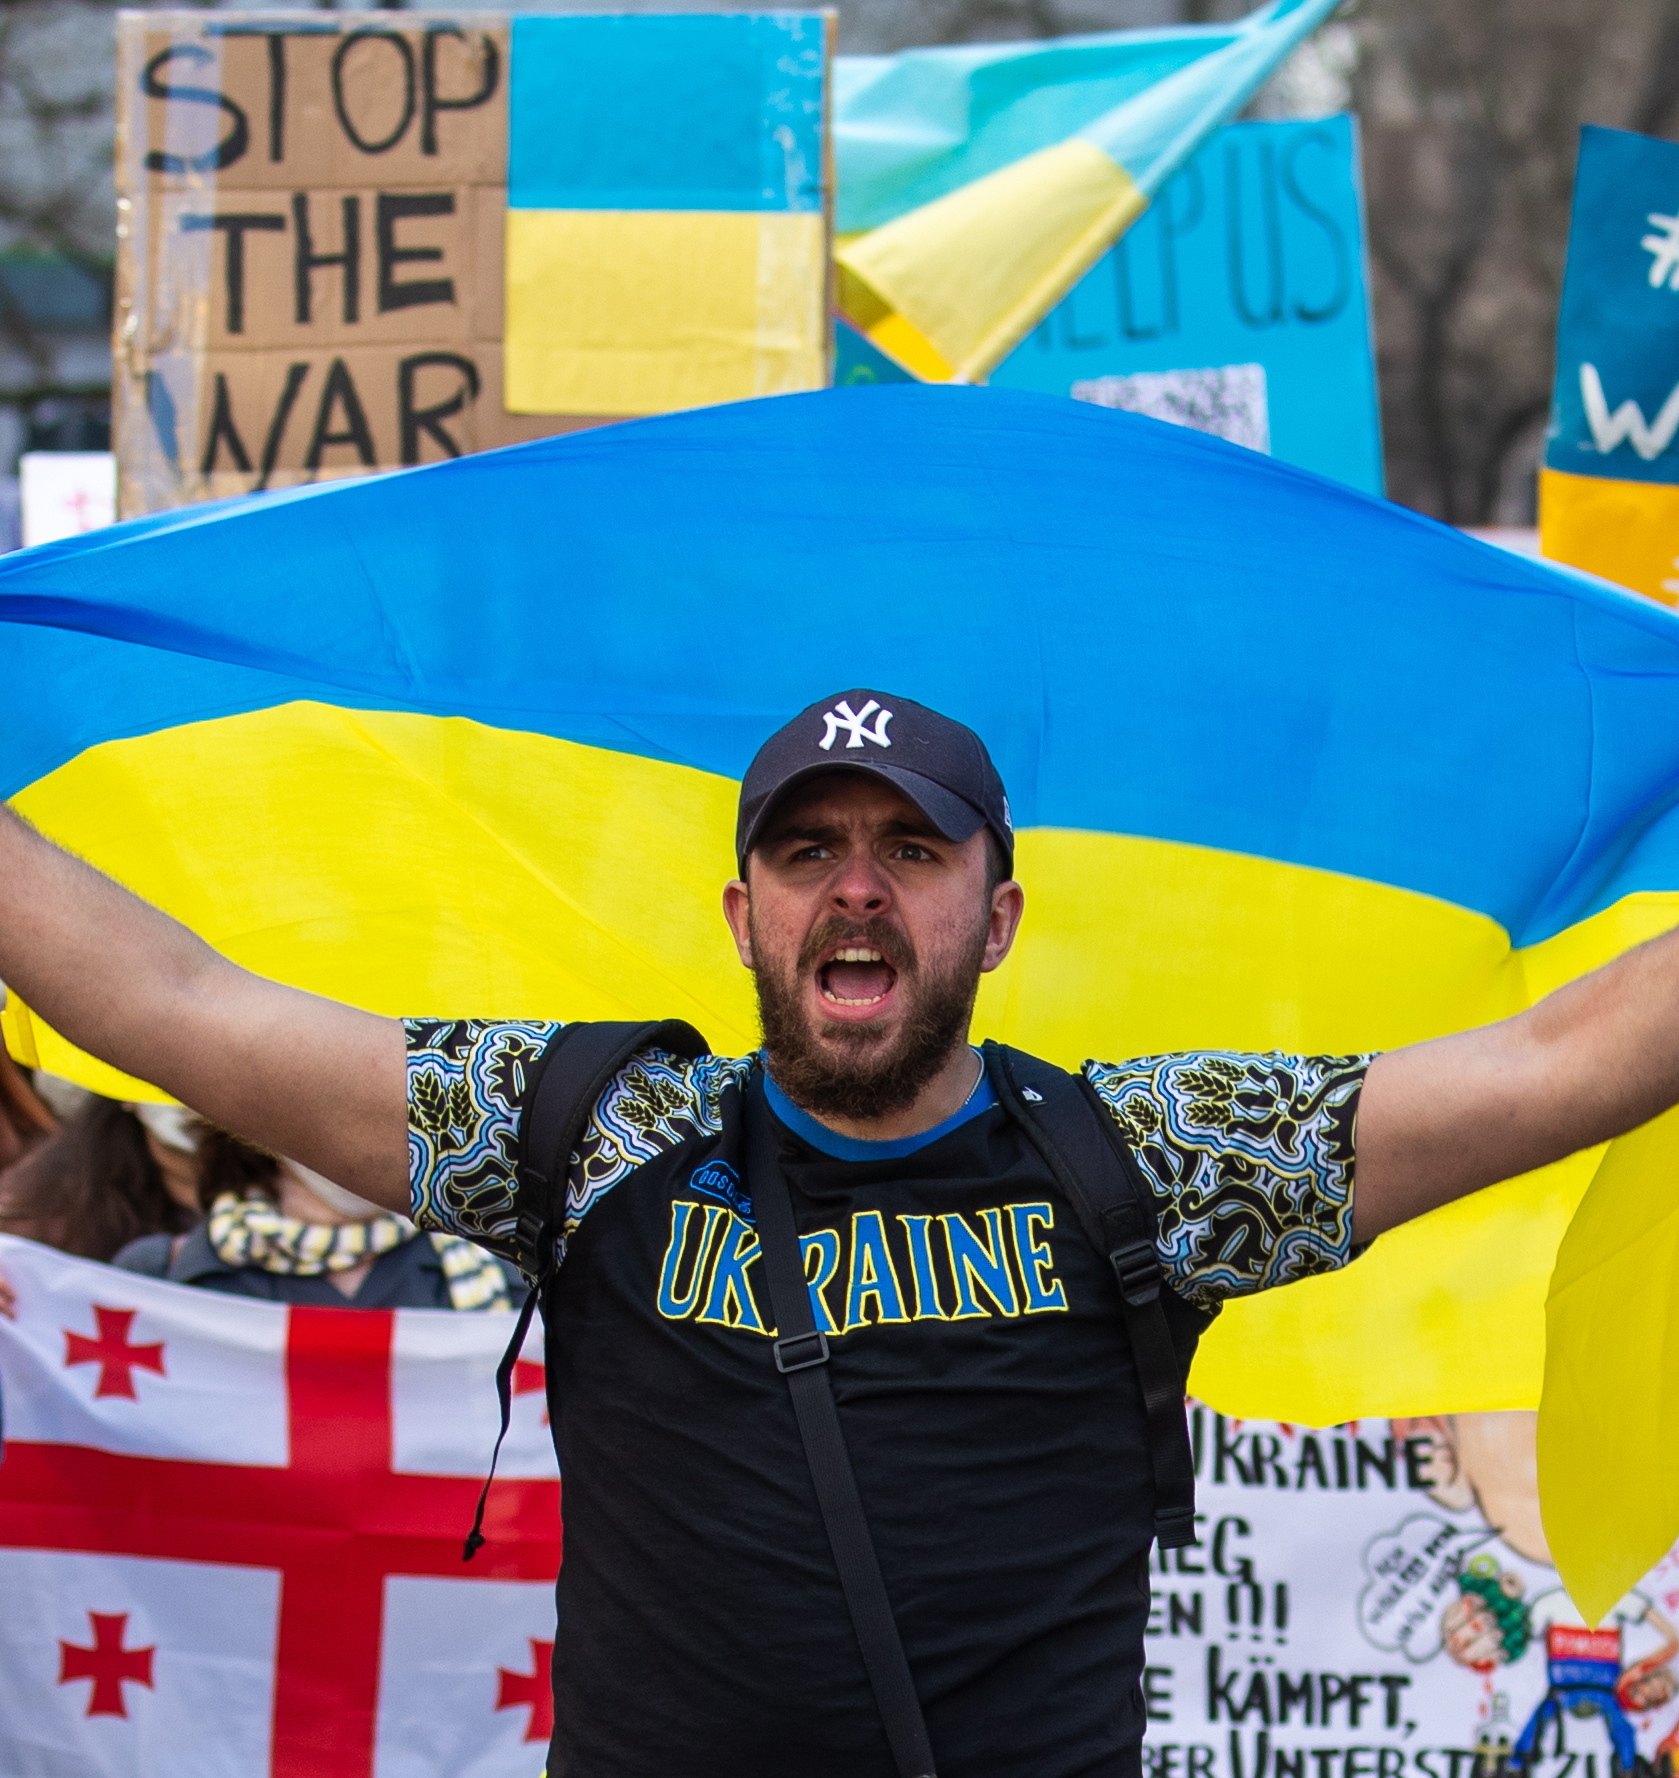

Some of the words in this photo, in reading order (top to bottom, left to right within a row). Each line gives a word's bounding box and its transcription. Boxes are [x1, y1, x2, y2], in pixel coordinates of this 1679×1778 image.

[140, 26, 500, 173] STOP
[180, 193, 458, 334] THE
[1225, 125, 1353, 332] US
[146, 352, 482, 492] WAR
[819, 700, 894, 751] NY
[657, 1200, 1069, 1336] UKRAINE
[1207, 1645, 1418, 1738] KÄMPFT,
